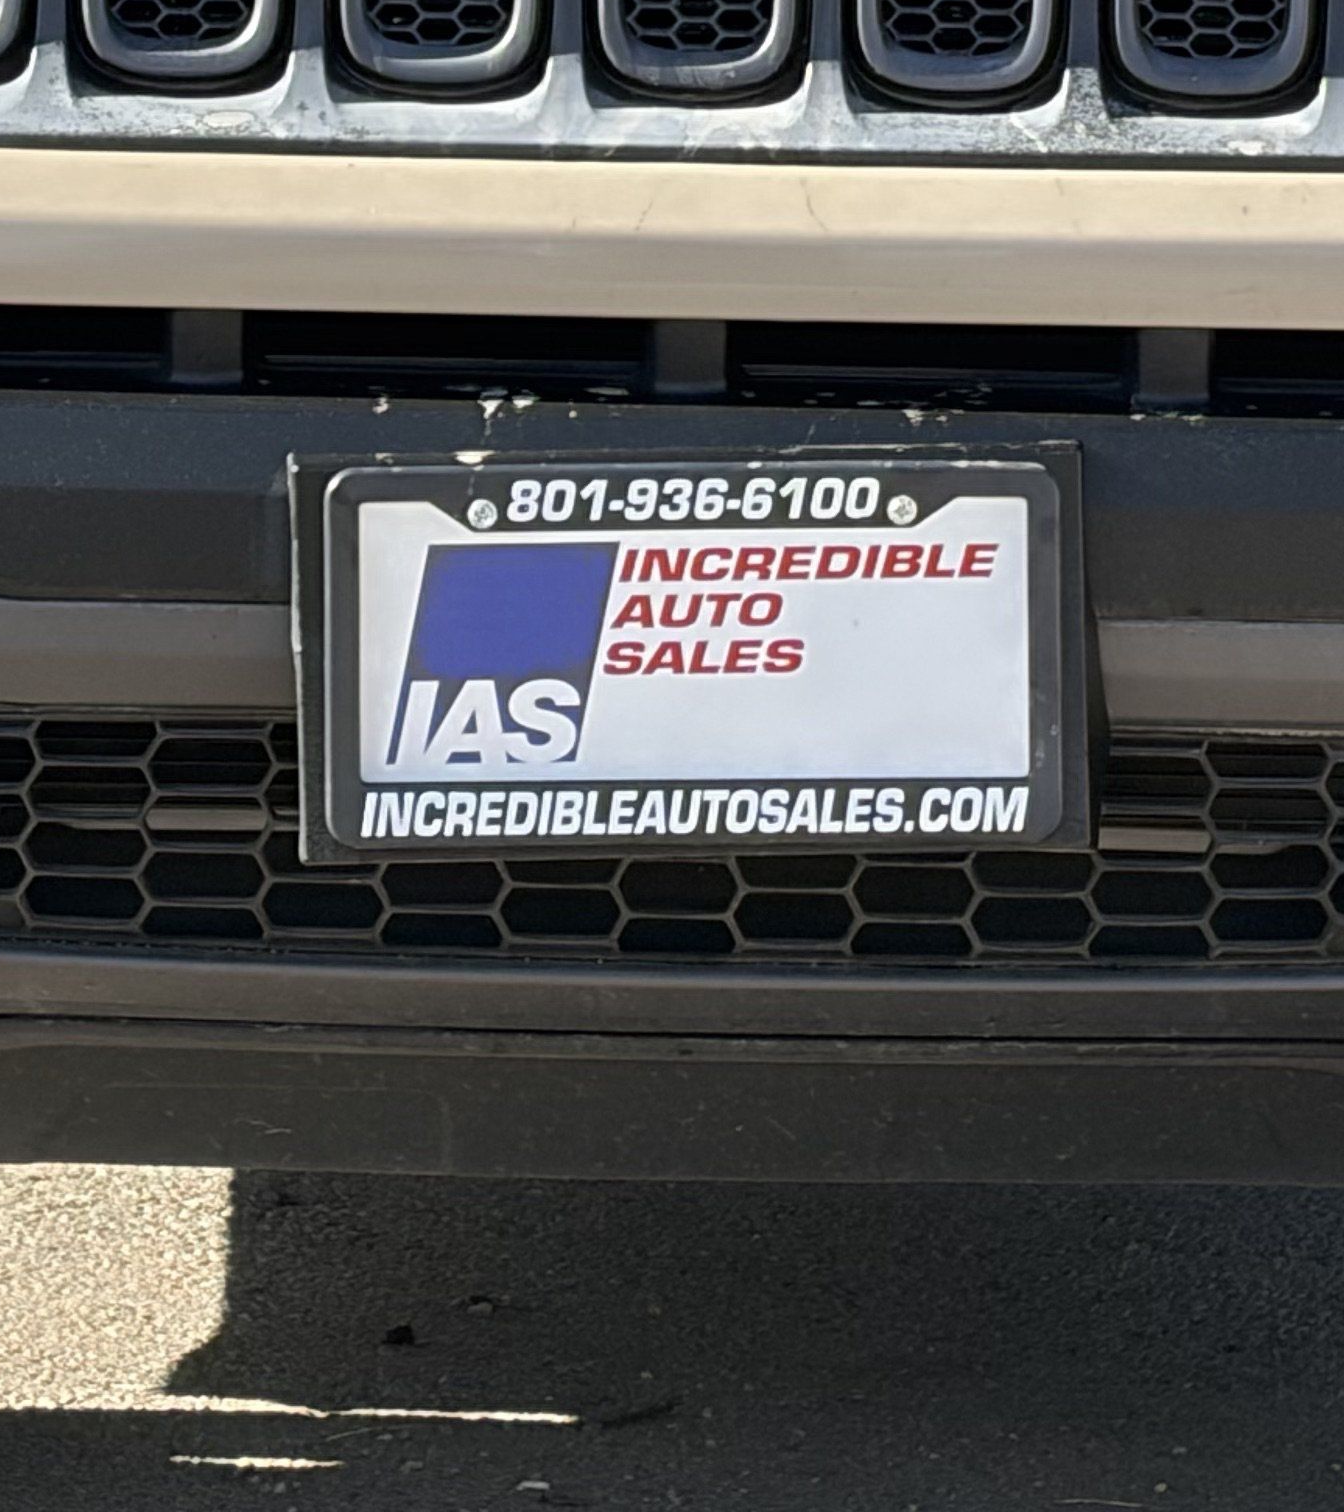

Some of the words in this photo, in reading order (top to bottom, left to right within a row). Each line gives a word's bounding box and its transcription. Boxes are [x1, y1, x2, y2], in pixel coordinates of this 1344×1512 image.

[505, 476, 880, 523] 801-936-6100
[618, 543, 998, 583] INCREDIBLE
[610, 592, 784, 629] AUTO
[602, 638, 805, 676] SALES
[394, 677, 582, 765] IAS
[360, 785, 1029, 839] INCREDIBLEAUTOSALES.COM
